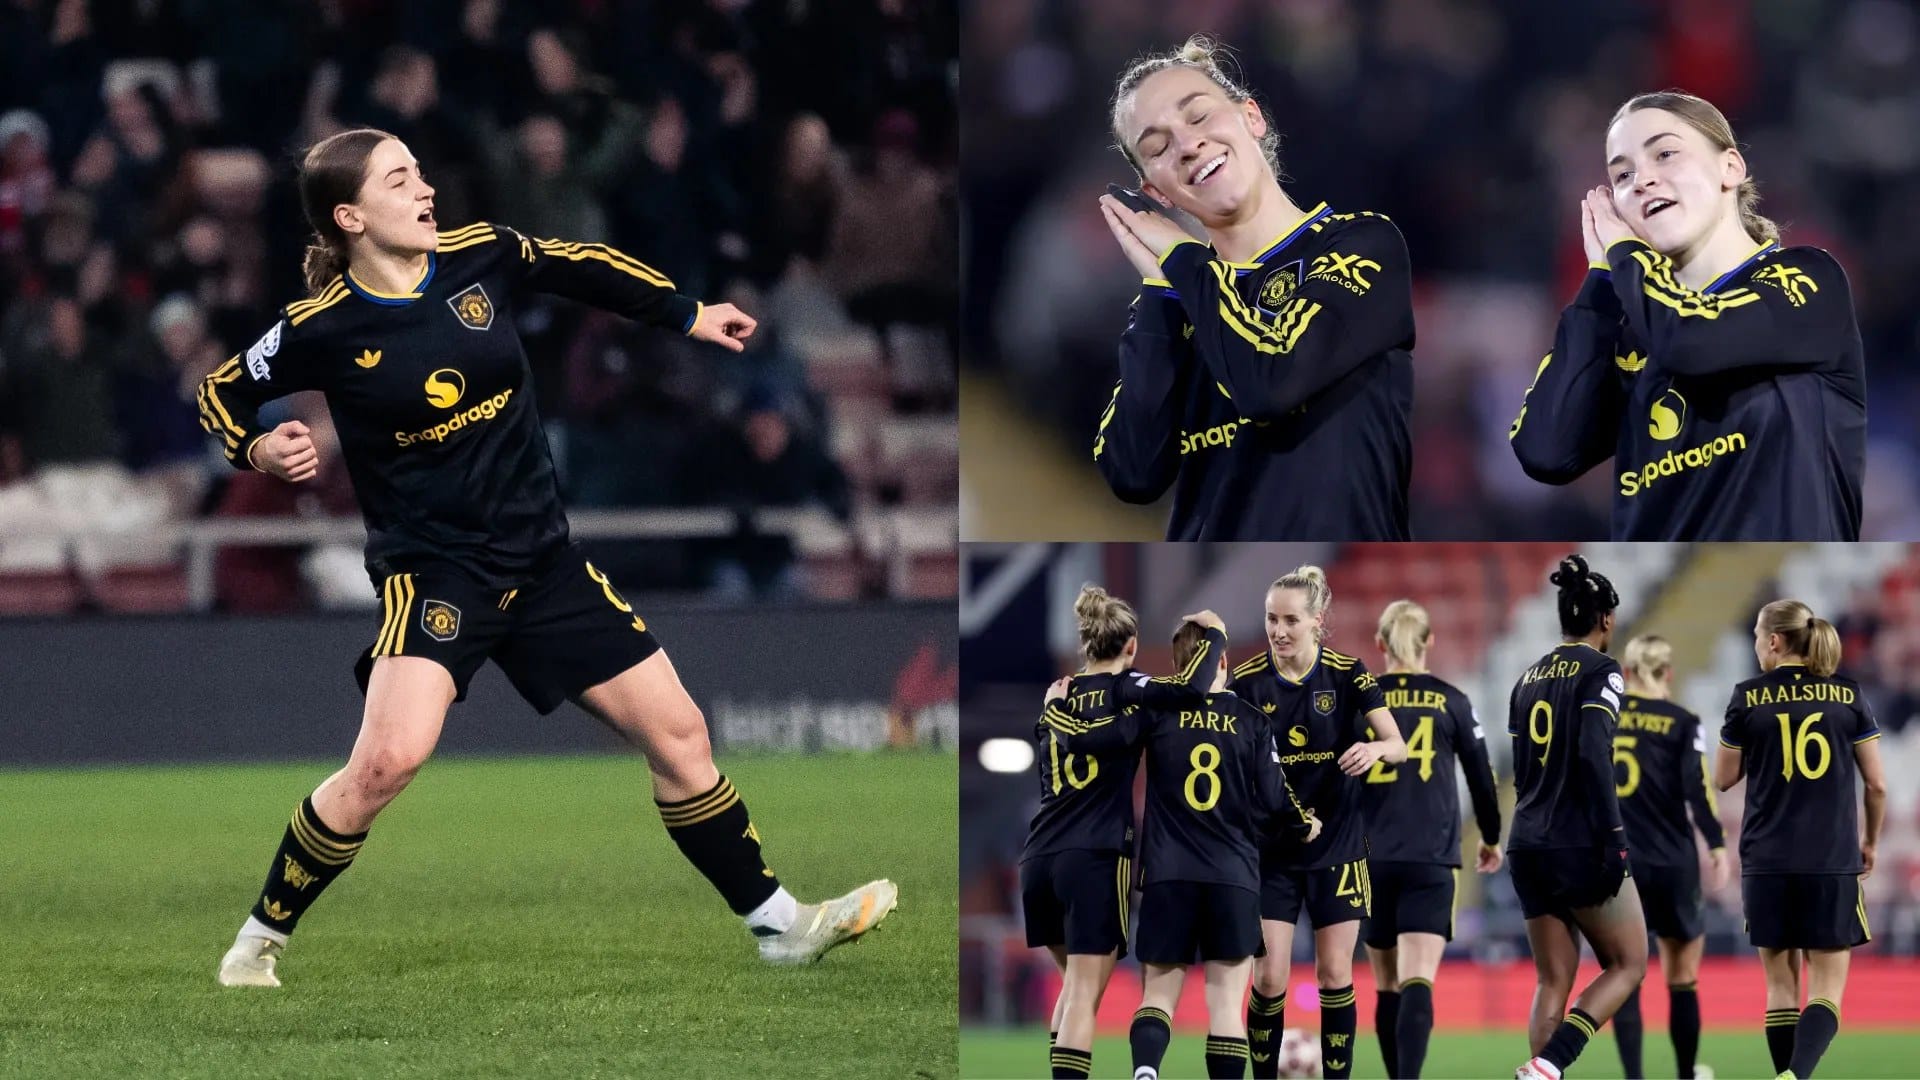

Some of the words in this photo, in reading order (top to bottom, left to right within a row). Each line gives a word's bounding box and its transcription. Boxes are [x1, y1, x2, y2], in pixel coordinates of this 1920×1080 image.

[1620, 432, 1746, 497] Spdragon
[1179, 710, 1238, 735] PARK
[1745, 683, 1856, 708] NAALSUND
[1278, 751, 1335, 766] apdragon
[1529, 699, 1553, 768] 9
[1775, 711, 1832, 783] 16
[1184, 742, 1222, 812] 8
